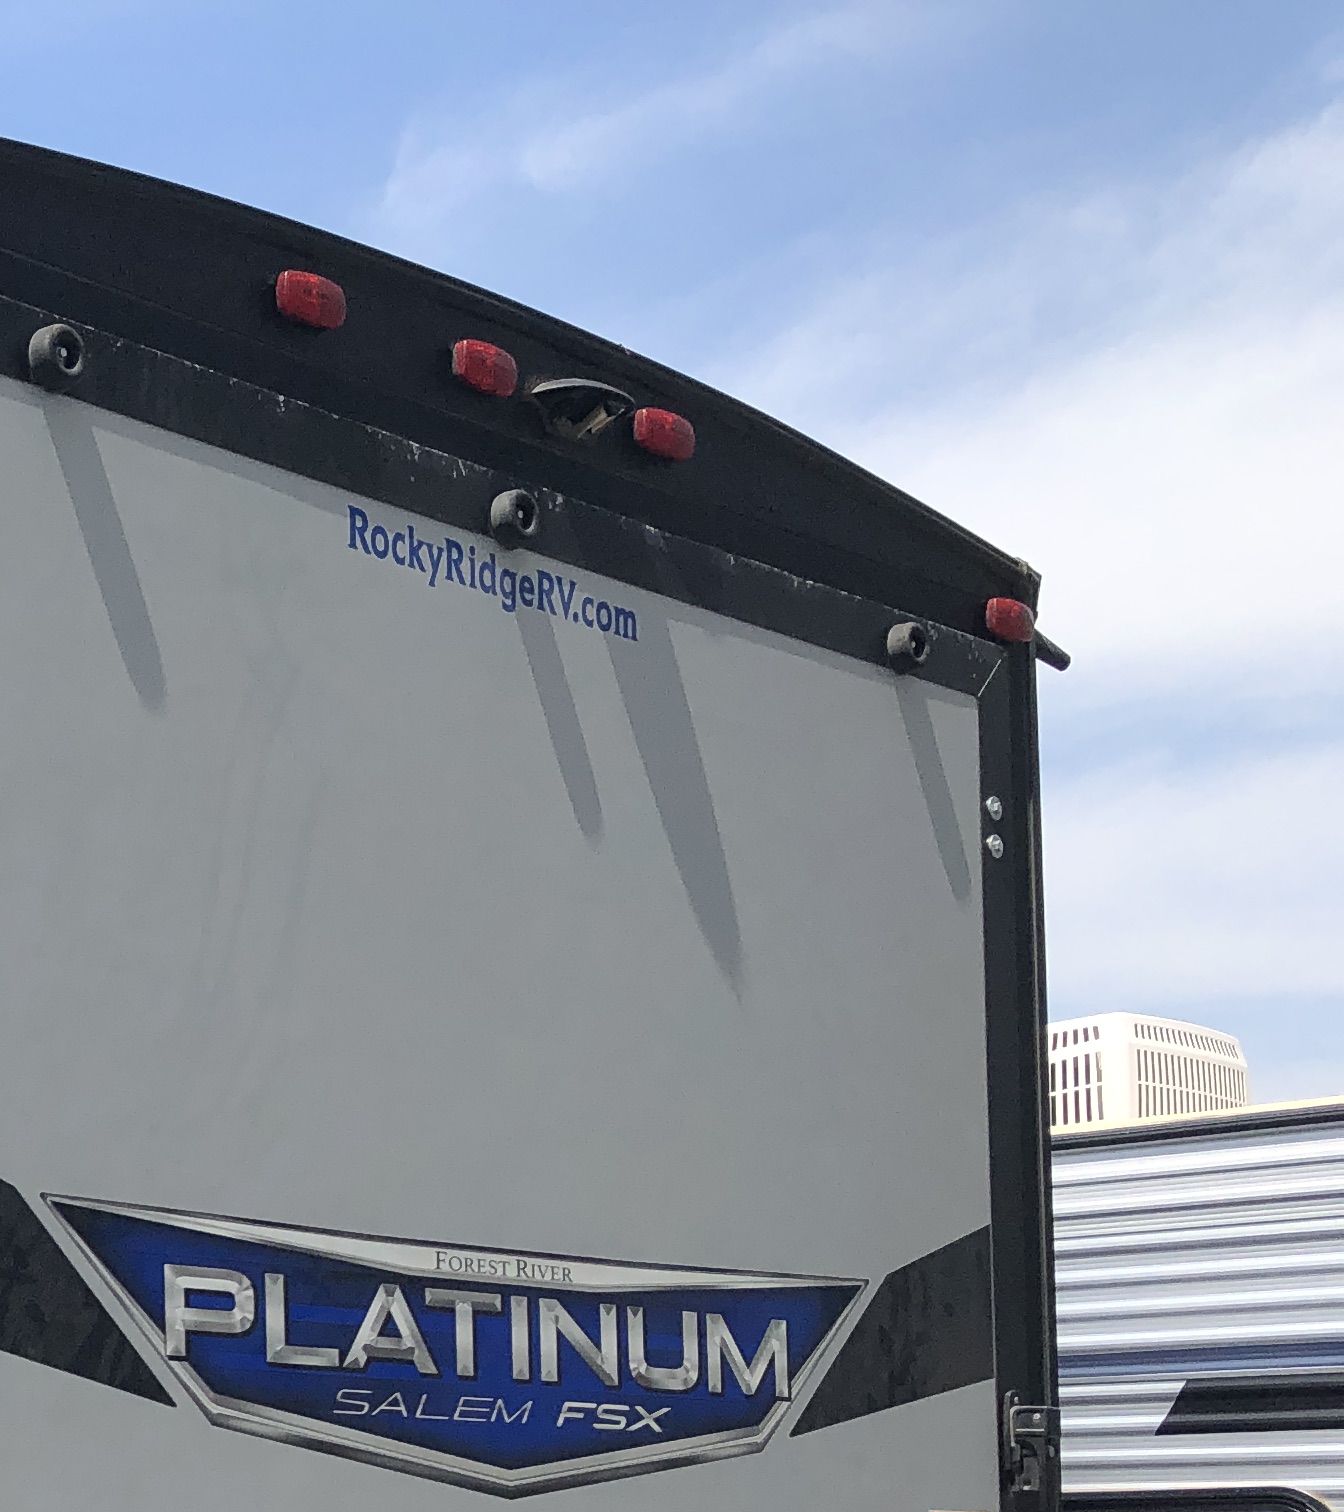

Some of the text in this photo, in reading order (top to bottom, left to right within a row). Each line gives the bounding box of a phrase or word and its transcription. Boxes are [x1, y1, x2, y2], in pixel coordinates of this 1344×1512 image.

[347, 504, 639, 642] RockyRidgeRV.com
[434, 1250, 573, 1283] FOREST RIVER
[162, 1263, 794, 1400] PLATINUM
[332, 1388, 672, 1434] SALEM FSX
